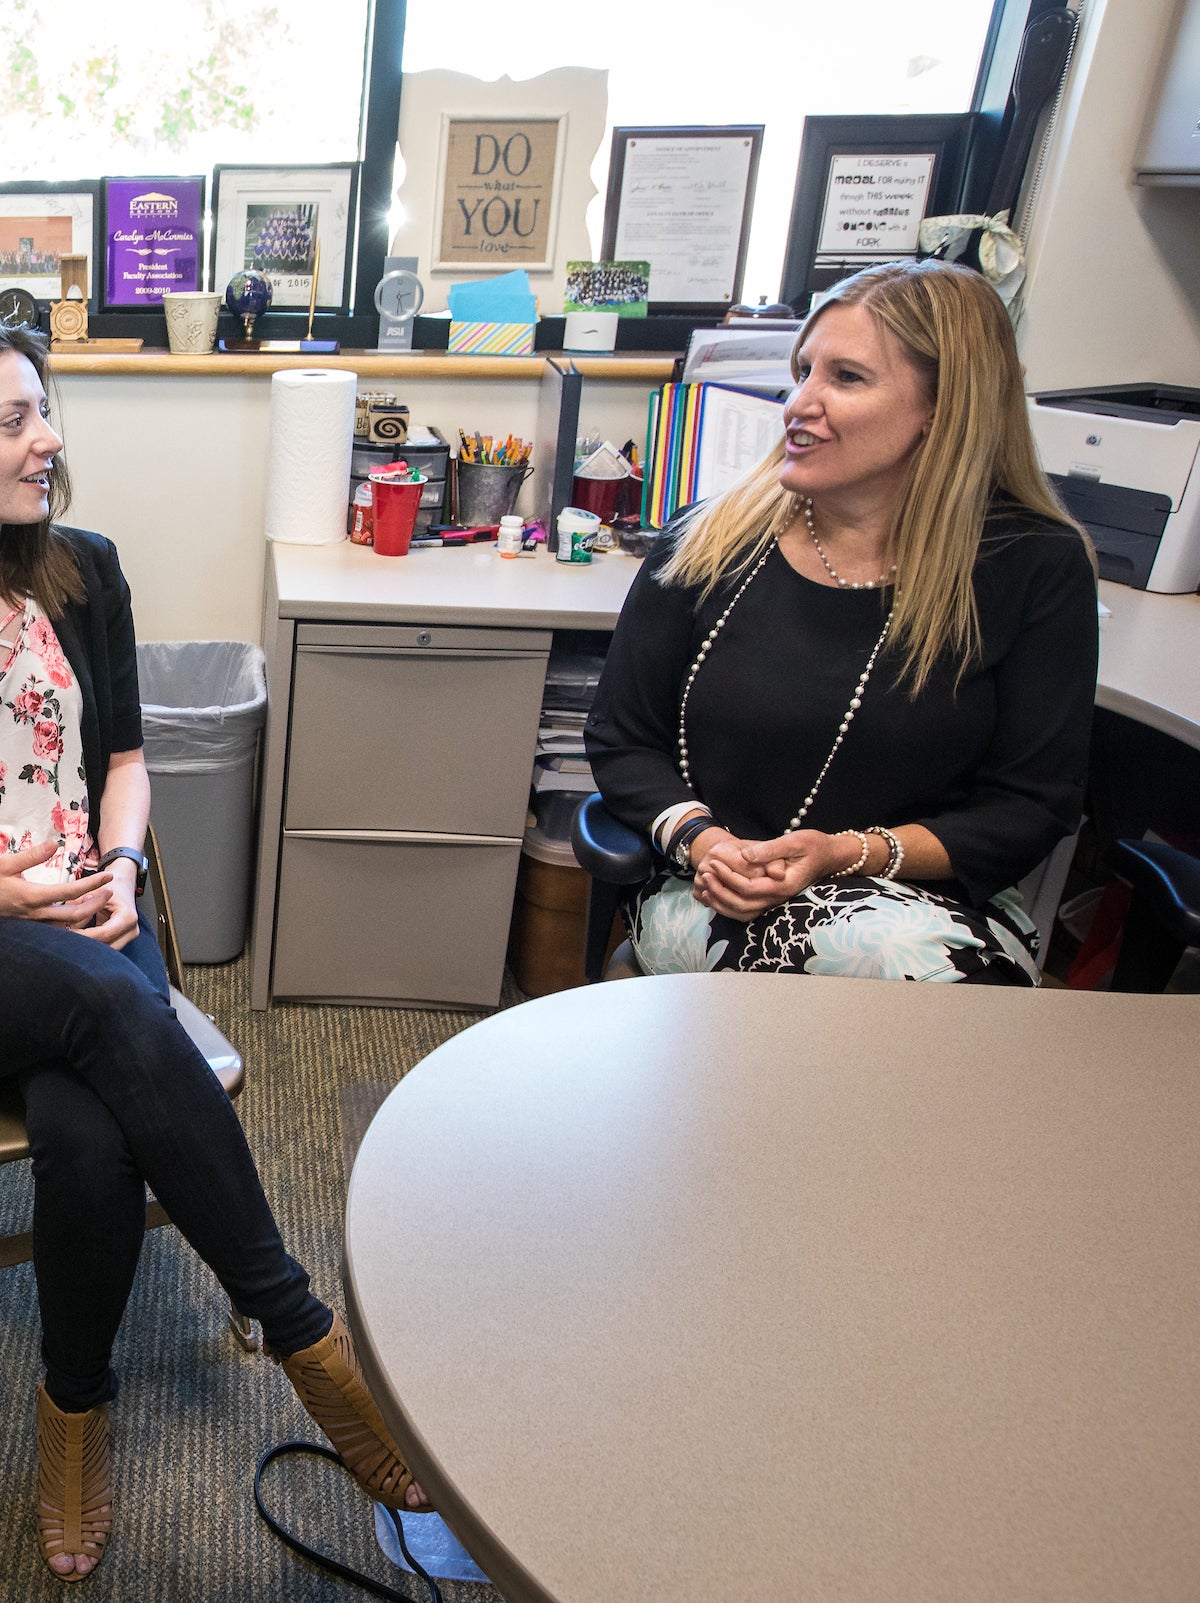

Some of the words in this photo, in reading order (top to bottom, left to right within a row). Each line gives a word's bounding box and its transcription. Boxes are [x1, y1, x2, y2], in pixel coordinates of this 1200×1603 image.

[472, 132, 532, 176] DO
[863, 158, 902, 167] DESERVE
[877, 175, 892, 184] FOR
[917, 175, 926, 184] IT
[483, 179, 516, 191] what
[867, 191, 883, 200] THIS
[884, 193, 914, 201] week
[129, 200, 178, 210] EASTERN
[457, 195, 541, 237] YOU
[839, 207, 871, 216] without
[113, 229, 144, 245] Carolyn
[479, 239, 509, 253] love
[138, 262, 168, 271] President
[123, 271, 146, 281] Faculty
[146, 271, 183, 279] Association
[272, 279, 282, 287] OF
[288, 279, 310, 288] 2015
[135, 286, 171, 294] 2009-2010
[386, 327, 405, 336] ASU
